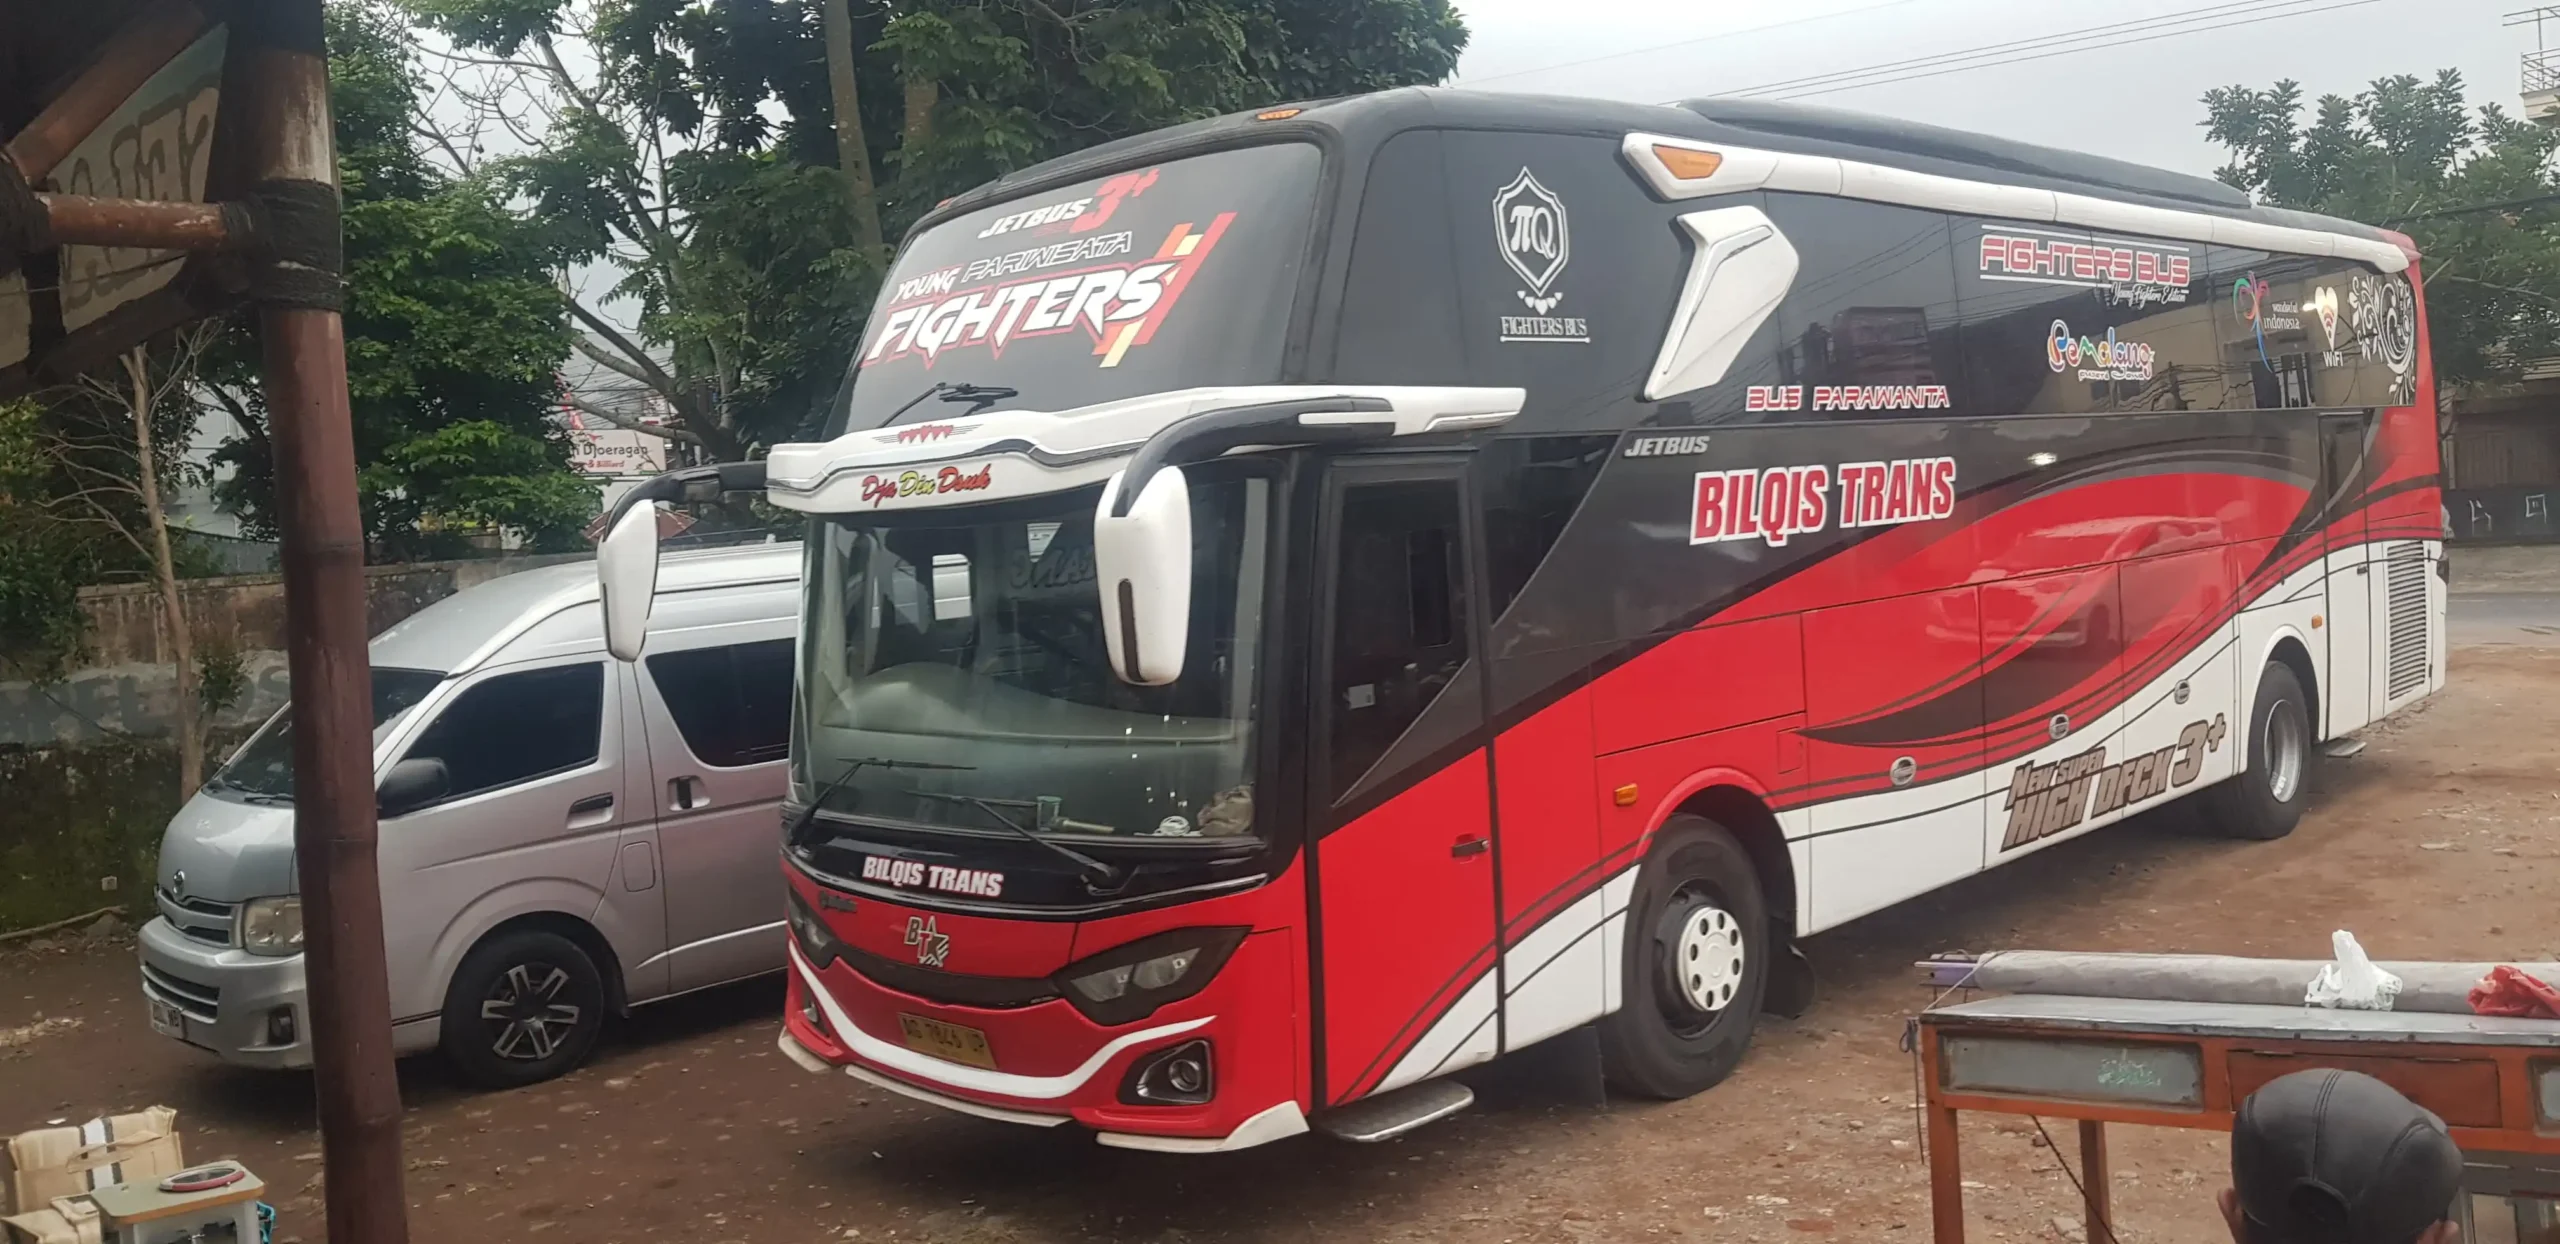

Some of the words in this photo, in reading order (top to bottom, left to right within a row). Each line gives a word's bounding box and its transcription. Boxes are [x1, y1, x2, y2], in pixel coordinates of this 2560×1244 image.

[977, 197, 1093, 239] JETBUS
[890, 268, 962, 305] YOUNG
[961, 230, 1134, 284] PARIWISATA
[1979, 234, 2133, 282] FIGHTERS
[2135, 250, 2190, 287] BUS
[862, 261, 1180, 362] FIGHTERS
[1500, 316, 1563, 336] FIGHTERS
[1564, 317, 1588, 336] BUS
[1745, 386, 1802, 412] BUS
[1812, 385, 1950, 411] PARAWANITA
[1624, 436, 1710, 457] JETBUS
[1689, 465, 1830, 548] BILQIS
[1837, 456, 1957, 528] TRANS
[2000, 774, 2095, 853] HIGH
[2090, 743, 2178, 820] DECK
[862, 855, 926, 888] BILQIS
[927, 865, 1004, 898] TRANS
